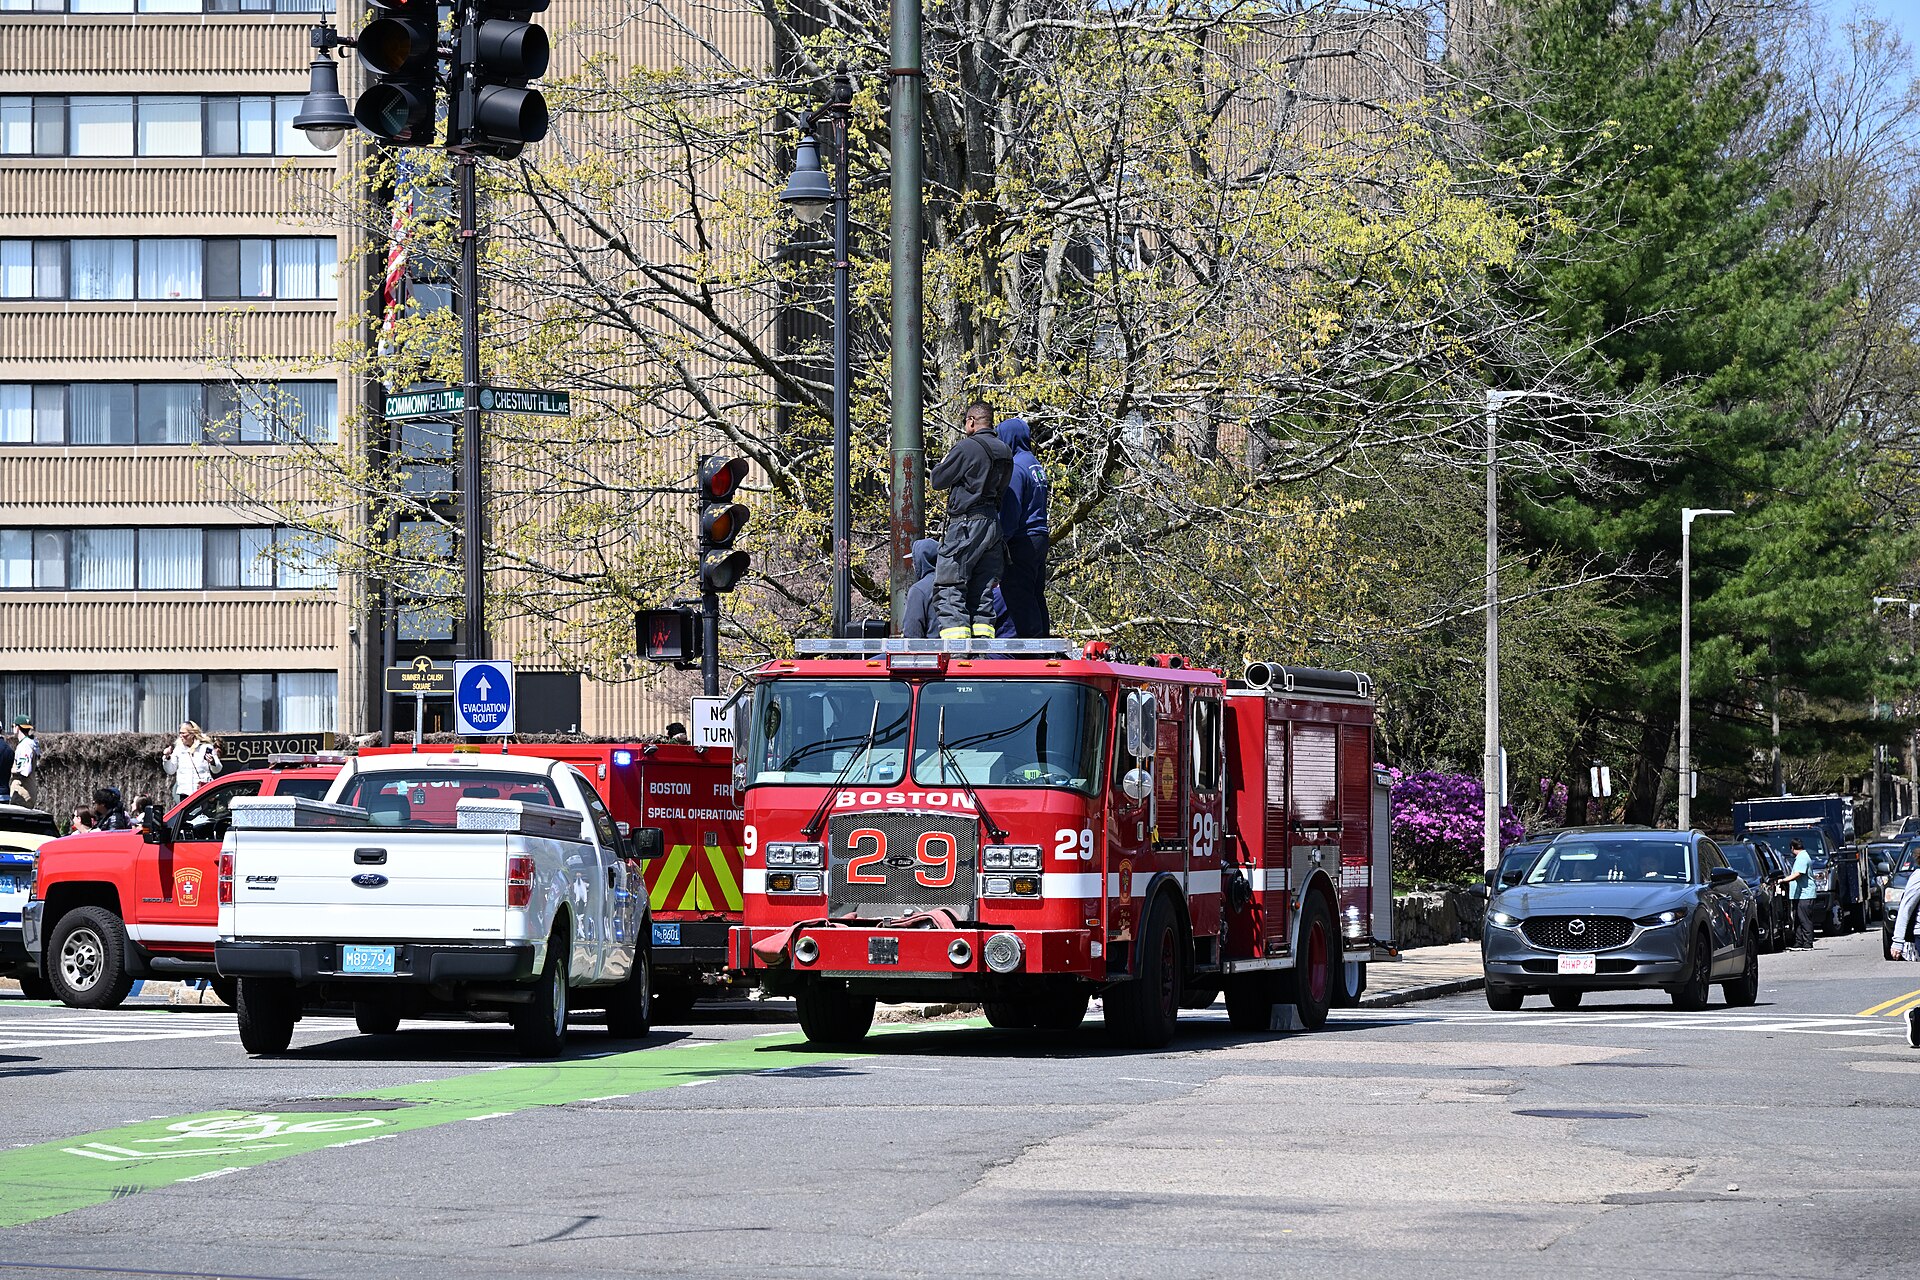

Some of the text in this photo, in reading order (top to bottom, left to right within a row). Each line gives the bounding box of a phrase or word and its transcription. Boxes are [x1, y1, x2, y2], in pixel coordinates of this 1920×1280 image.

[386, 392, 454, 415] COMMONWEALTH
[495, 391, 568, 413] CHESTNUT HILL AVE
[463, 703, 507, 713] EVACUATION
[710, 706, 727, 721] NO
[472, 713, 498, 723] ROUTE
[703, 727, 734, 743] TURN
[226, 739, 318, 763] ESERVOIR
[650, 782, 691, 795] BOSTON
[836, 791, 976, 809] BOSTON
[648, 808, 744, 821] SPECIAL OPERATIONS
[1193, 813, 1214, 857] 29
[1054, 829, 1094, 860] 29
[847, 828, 957, 887] 29
[177, 876, 199, 884] BOSTON
